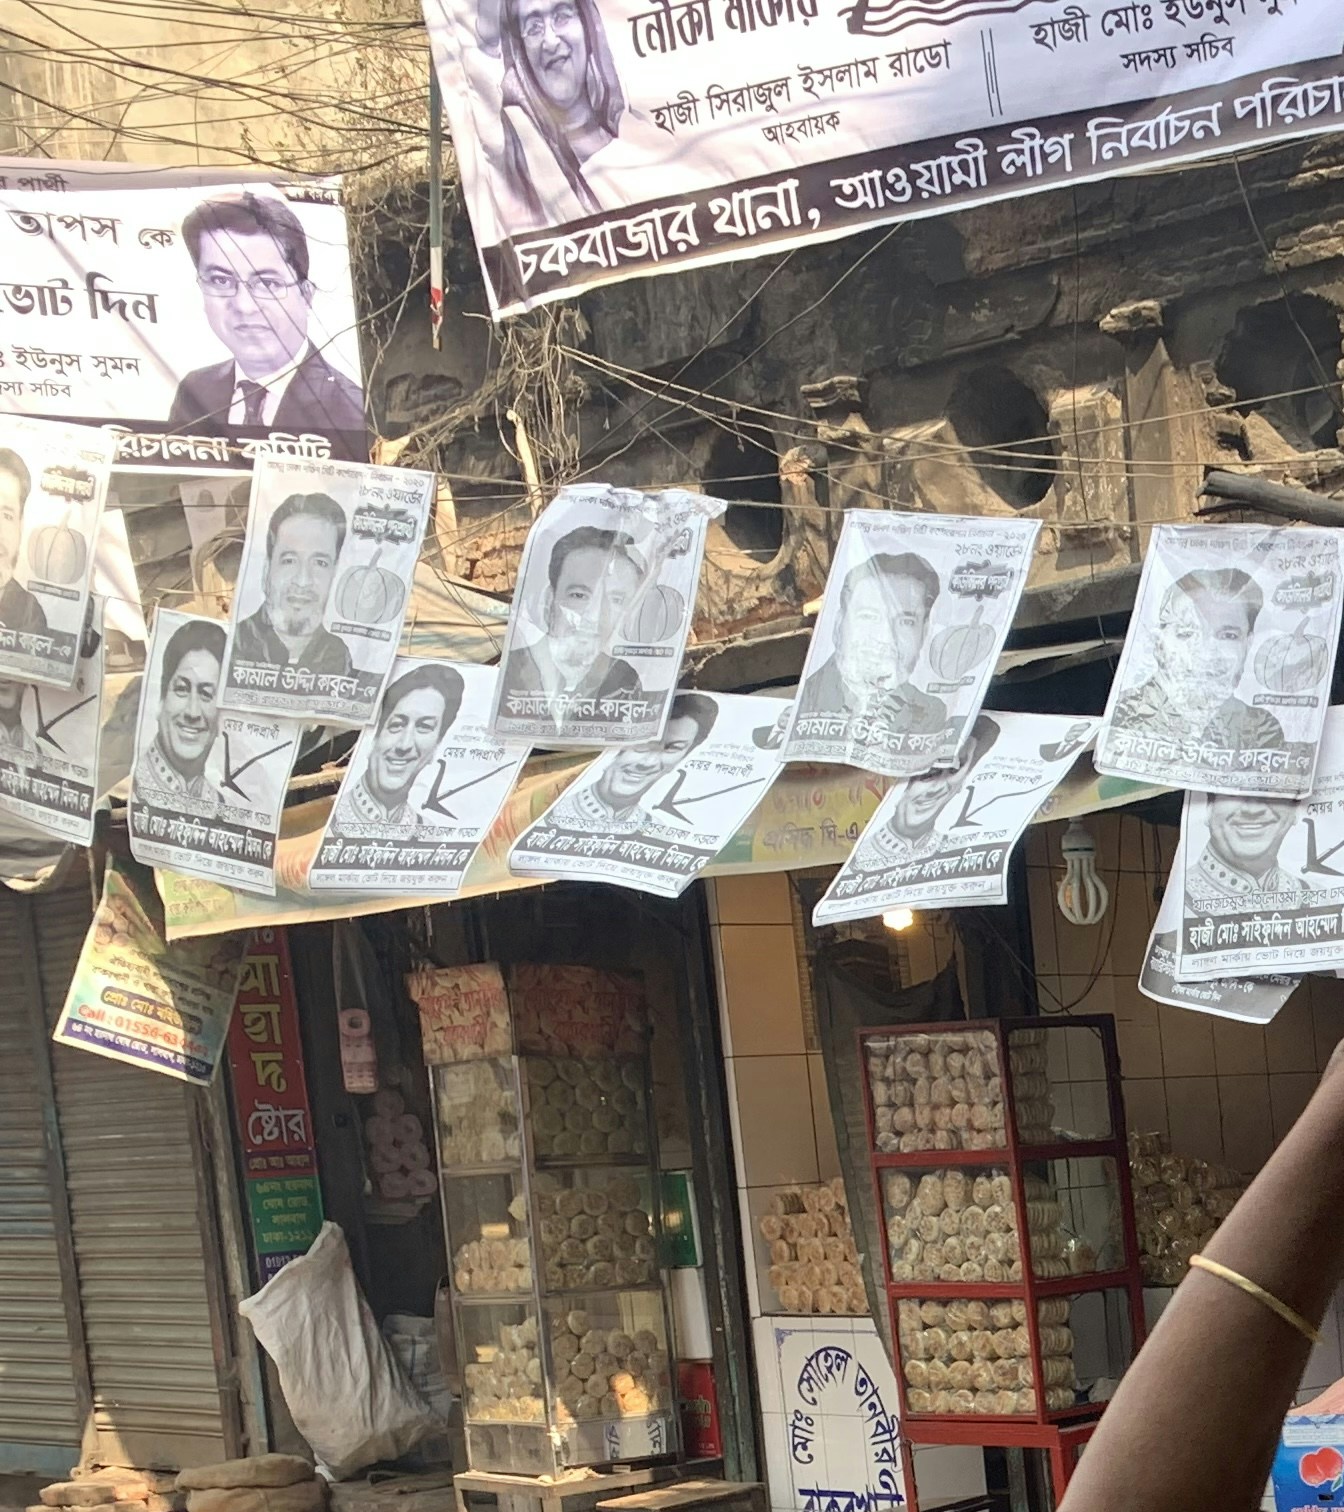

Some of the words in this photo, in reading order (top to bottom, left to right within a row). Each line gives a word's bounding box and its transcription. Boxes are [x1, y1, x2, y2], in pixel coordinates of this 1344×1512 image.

[627, 0, 714, 57] নৌকা
[1030, 7, 1091, 52] হাজী
[1101, 1, 1153, 37] মোঃ
[1120, 45, 1177, 73] সদস্য
[1183, 32, 1234, 64] সচিব
[650, 90, 700, 134] হাজী
[707, 75, 791, 119] সিরাজুল
[798, 57, 880, 99] ইসলাম
[512, 201, 700, 286] চকবাজার
[710, 178, 822, 231] থানা,
[830, 137, 990, 209] আওয়ামী
[997, 126, 1077, 179] লীগ
[1086, 97, 1223, 166] নির্বাচন
[4, 210, 123, 248] তাপস
[138, 228, 176, 249] কে
[83, 270, 159, 324] দিন
[12, 344, 83, 377] ইউনুস
[91, 355, 141, 378] সুমন
[30, 378, 73, 398] সচিব
[104, 424, 231, 463] রিচালনা
[232, 665, 278, 689] কামাল
[506, 695, 552, 717] কামাল
[795, 714, 847, 740] কামাল
[1112, 731, 1176, 761] কামাল
[1181, 740, 1235, 768] উদ্দিন
[1306, 800, 1334, 817] মেয়র
[1189, 918, 1216, 950] হাজী
[1216, 922, 1240, 944] মোঃ
[77, 1003, 106, 1022] Call
[247, 1098, 307, 1146] ষ্টোর
[798, 1346, 853, 1406] সোহেল
